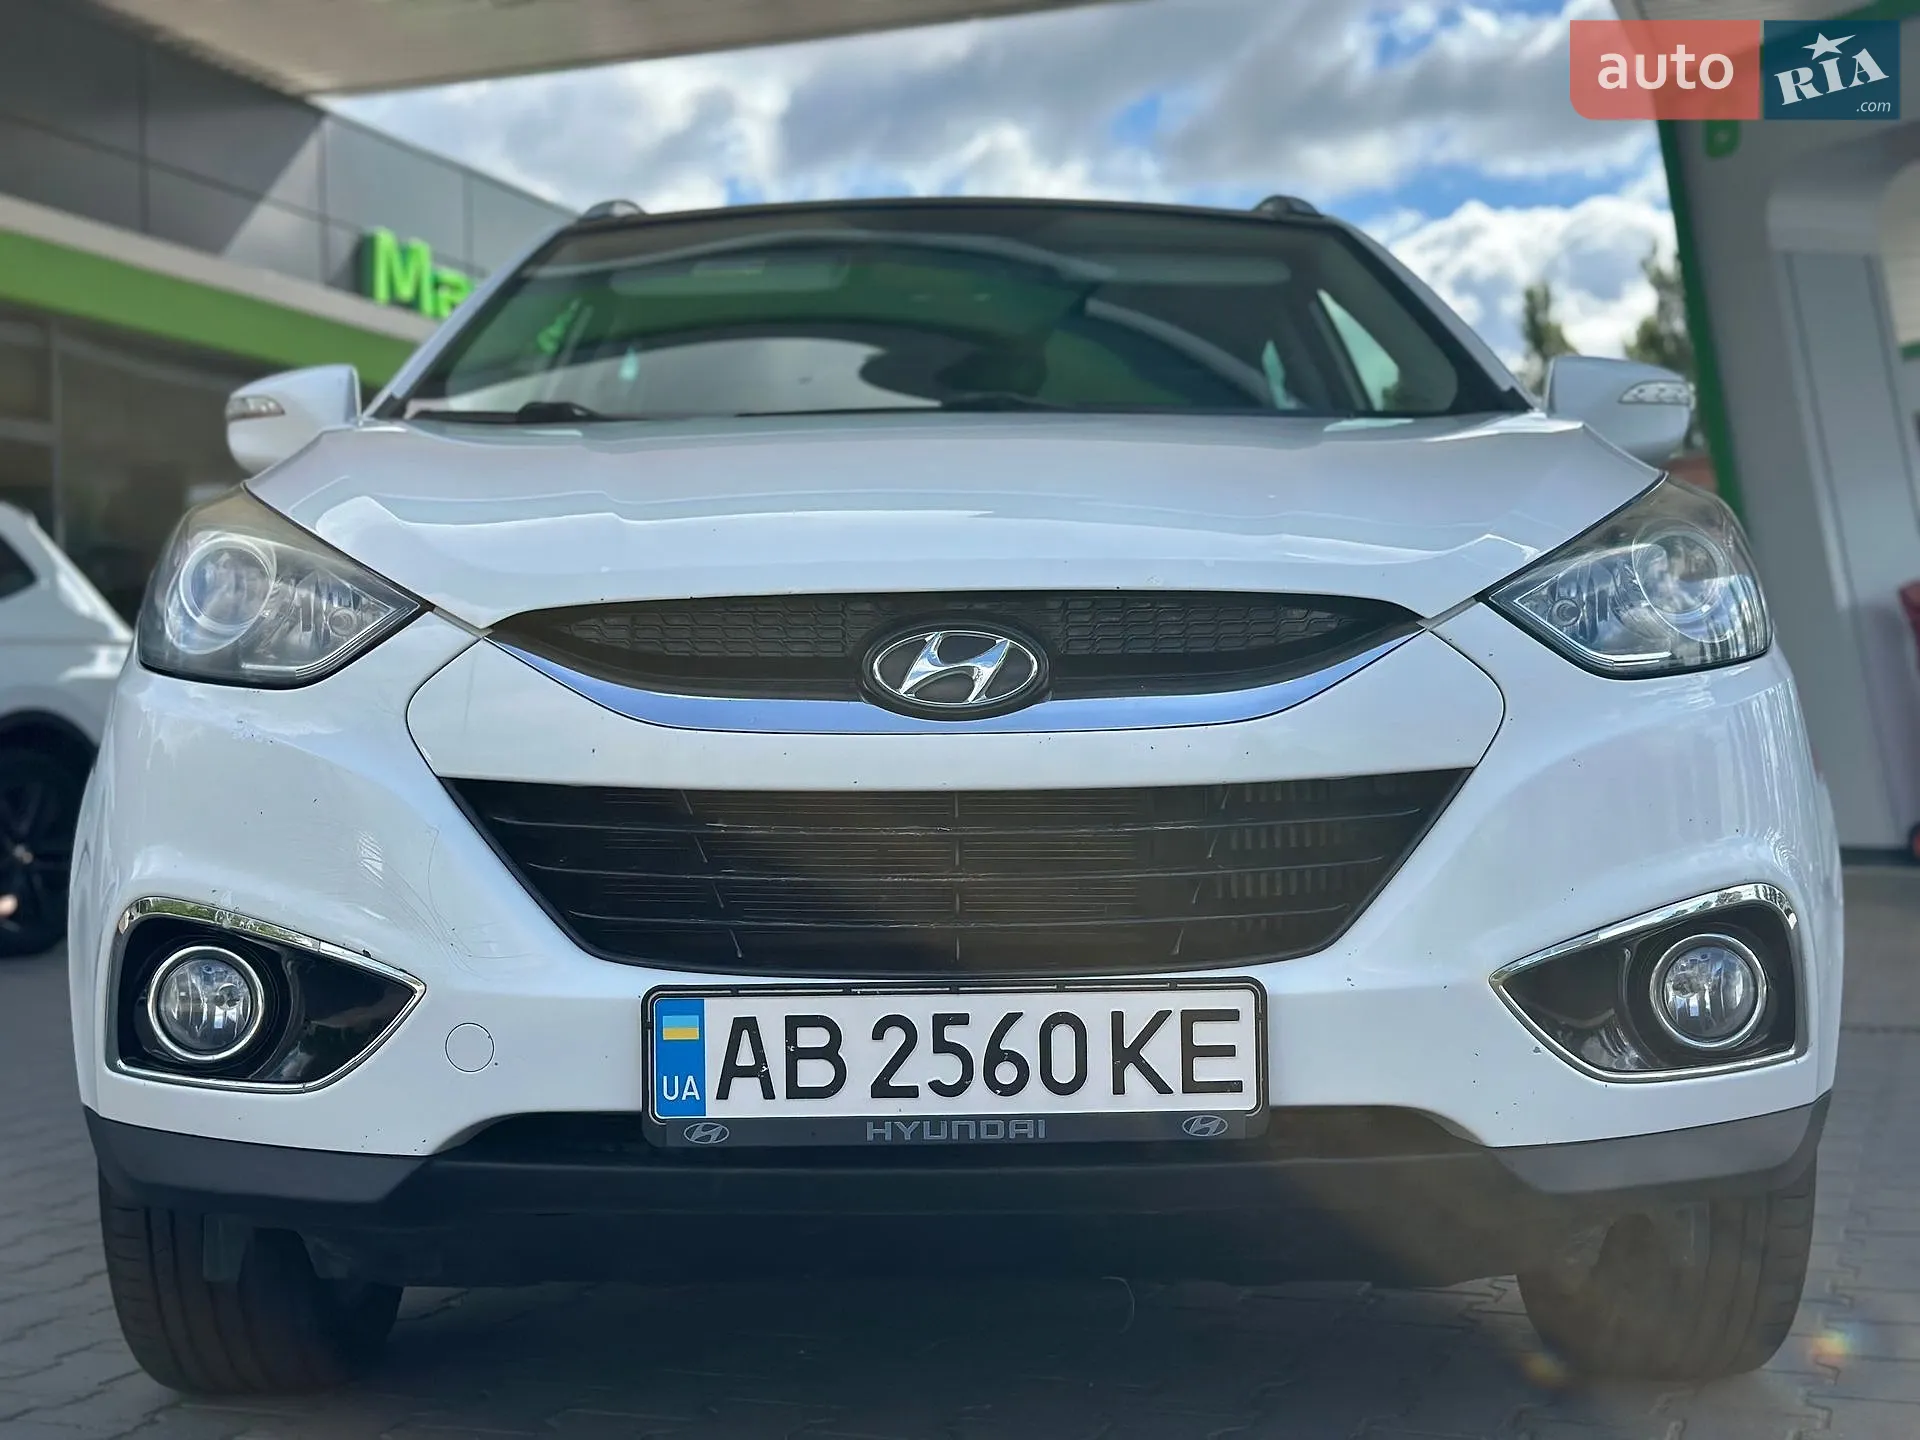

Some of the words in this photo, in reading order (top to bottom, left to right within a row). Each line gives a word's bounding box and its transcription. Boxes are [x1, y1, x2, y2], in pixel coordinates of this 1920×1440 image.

[716, 1014, 848, 1100] AB
[870, 1011, 1088, 1099] 2560
[1111, 1008, 1243, 1095] KE
[662, 1075, 701, 1101] UA
[866, 1118, 1046, 1143] HYUNDAI
